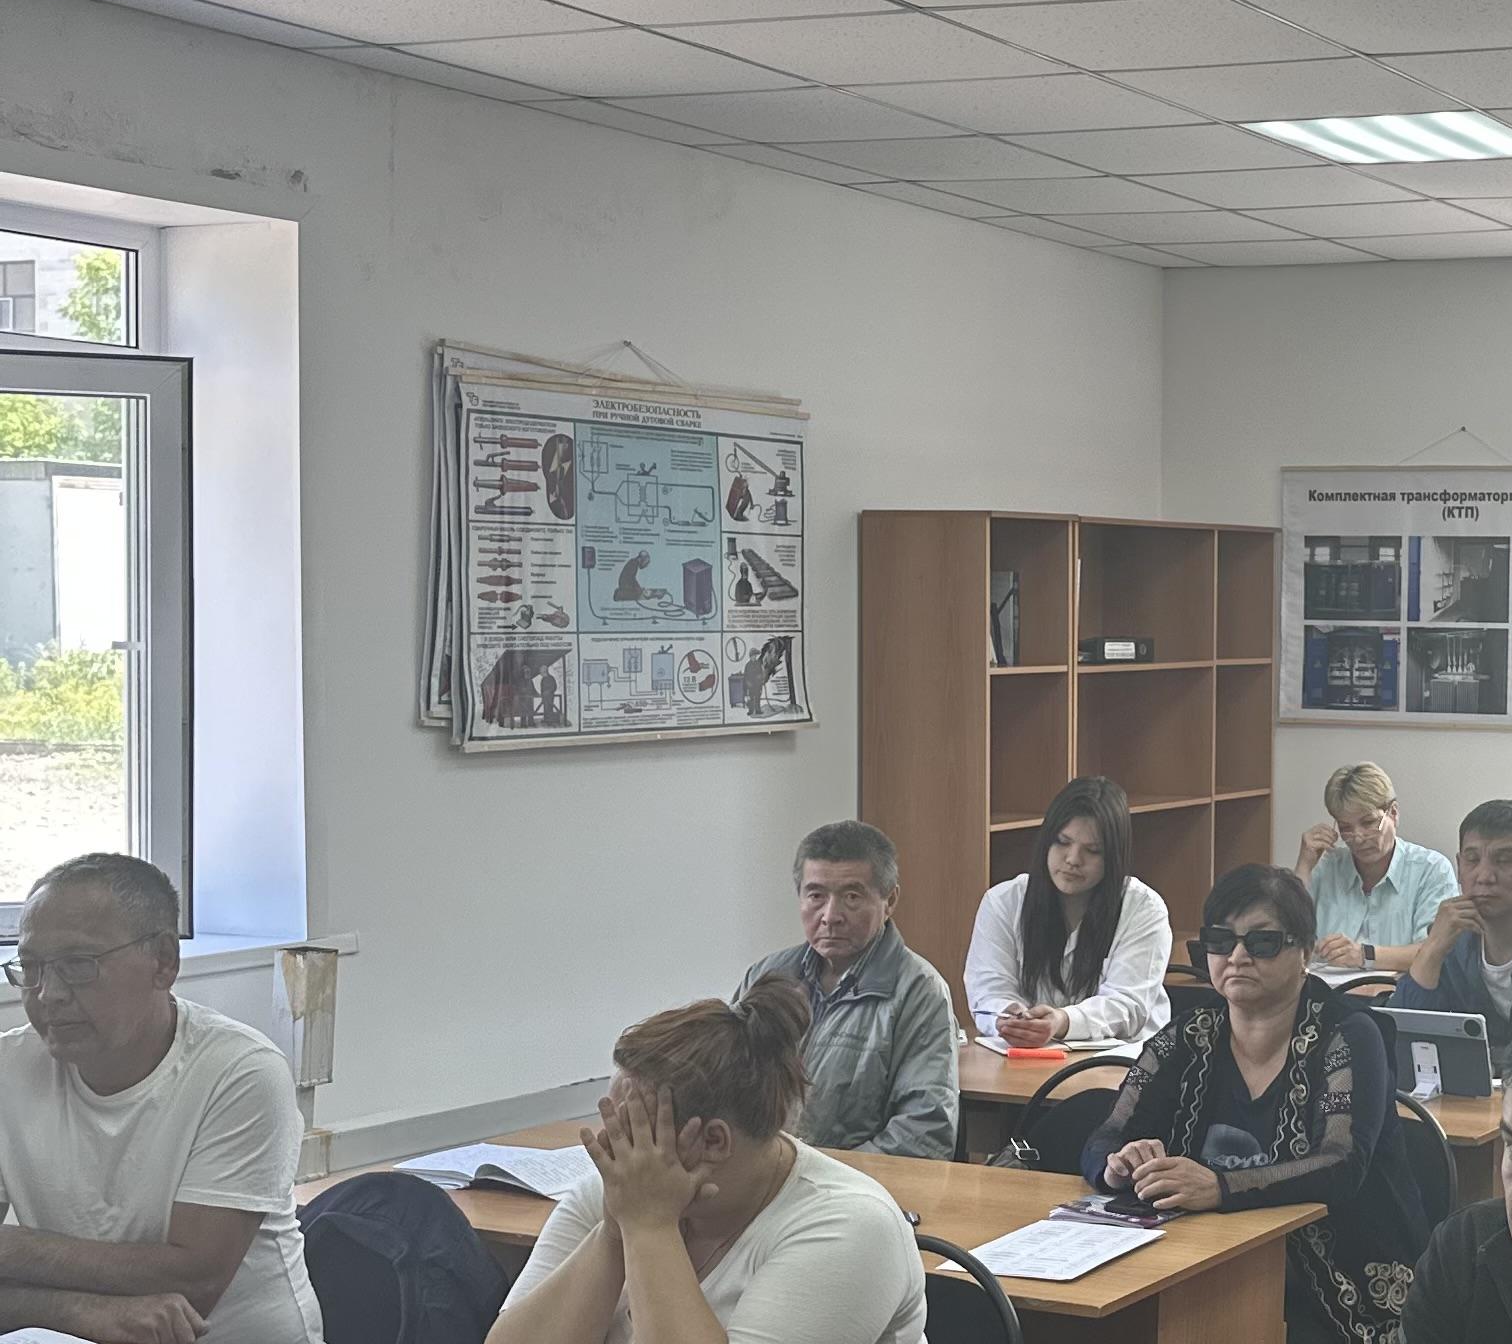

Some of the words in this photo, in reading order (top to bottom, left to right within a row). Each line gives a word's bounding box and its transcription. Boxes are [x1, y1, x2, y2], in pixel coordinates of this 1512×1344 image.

[592, 399, 702, 419] ЭЛЕКТРОБЕЗОПАСНОСТЬ
[592, 410, 608, 419] ПРИ
[610, 412, 640, 423] РУЧНОЙ
[1308, 489, 1396, 503] Комплектная
[1441, 506, 1479, 521] (КТП)
